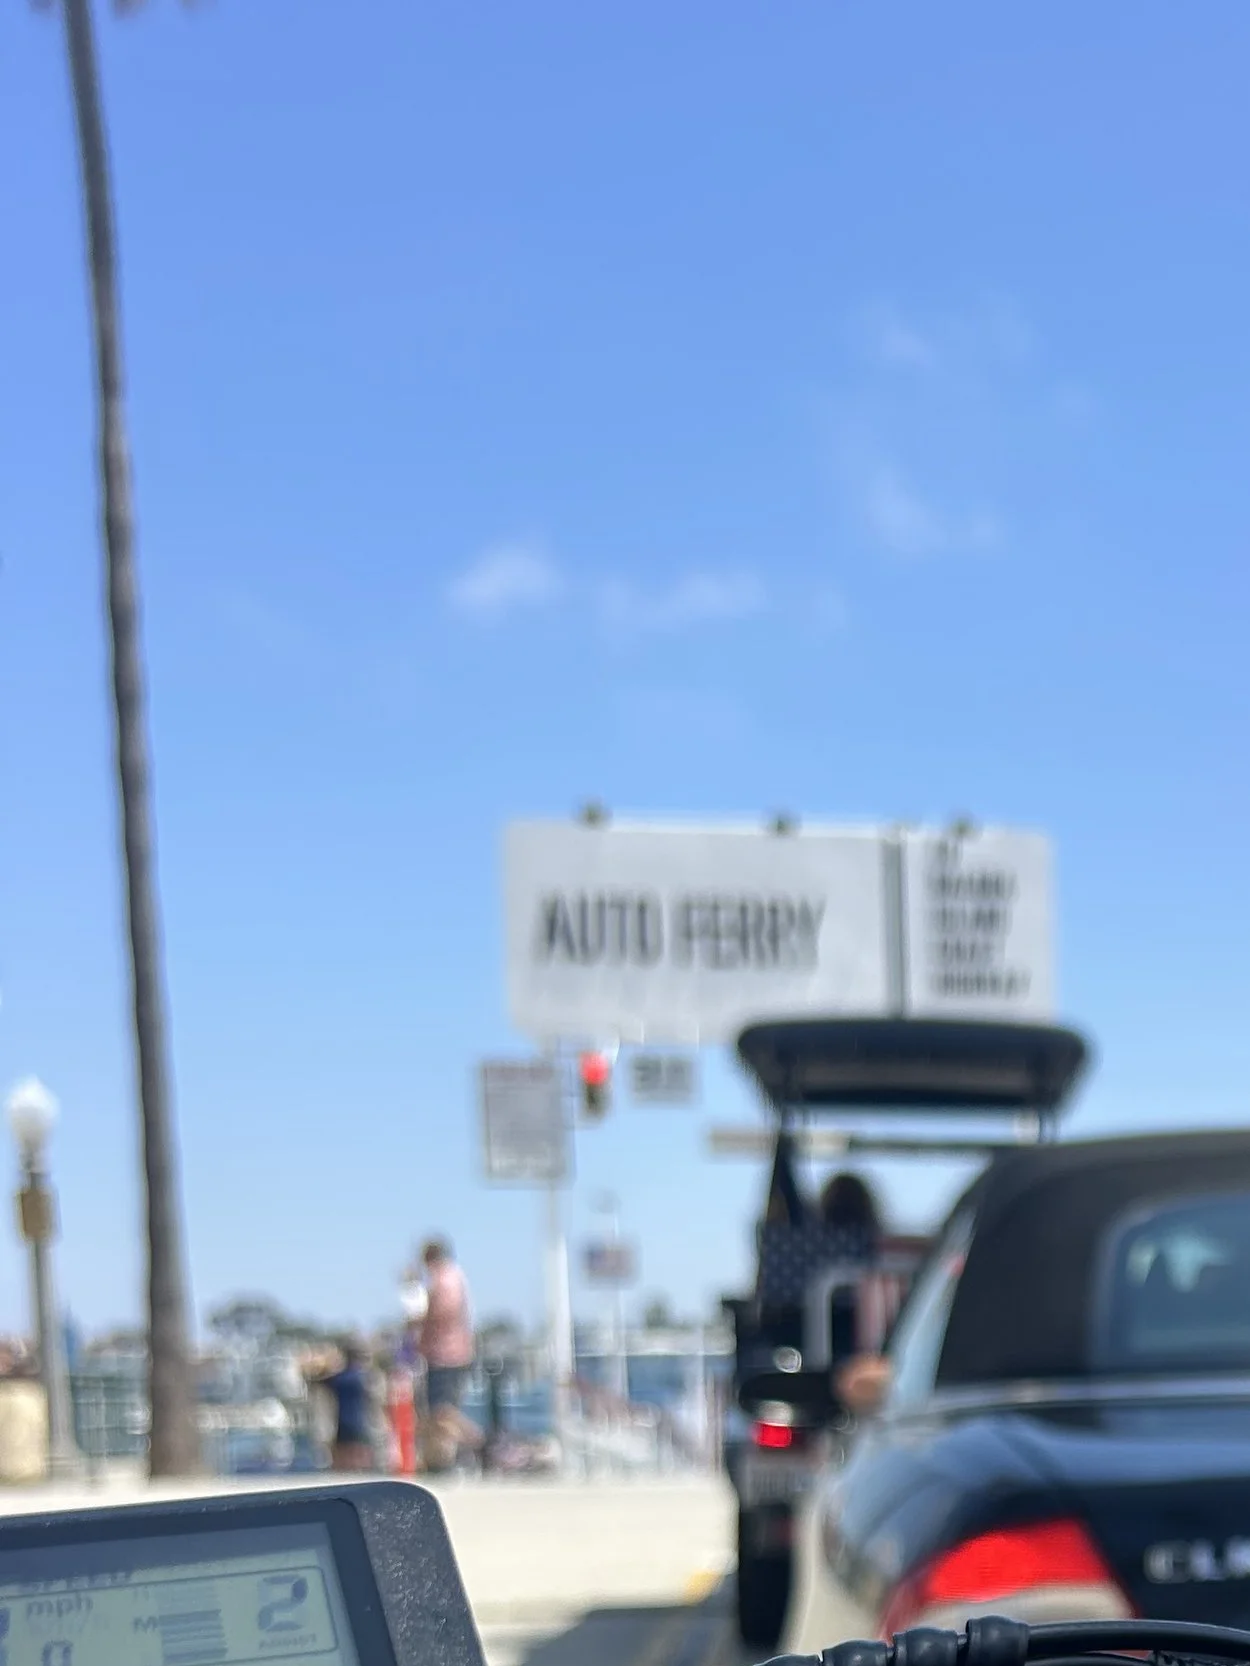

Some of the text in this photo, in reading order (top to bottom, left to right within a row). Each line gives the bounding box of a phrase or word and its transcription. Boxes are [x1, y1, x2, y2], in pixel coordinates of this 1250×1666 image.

[537, 889, 825, 971] AUTO FERRY
[26, 1592, 94, 1619] mph
[257, 1575, 309, 1632] 2
